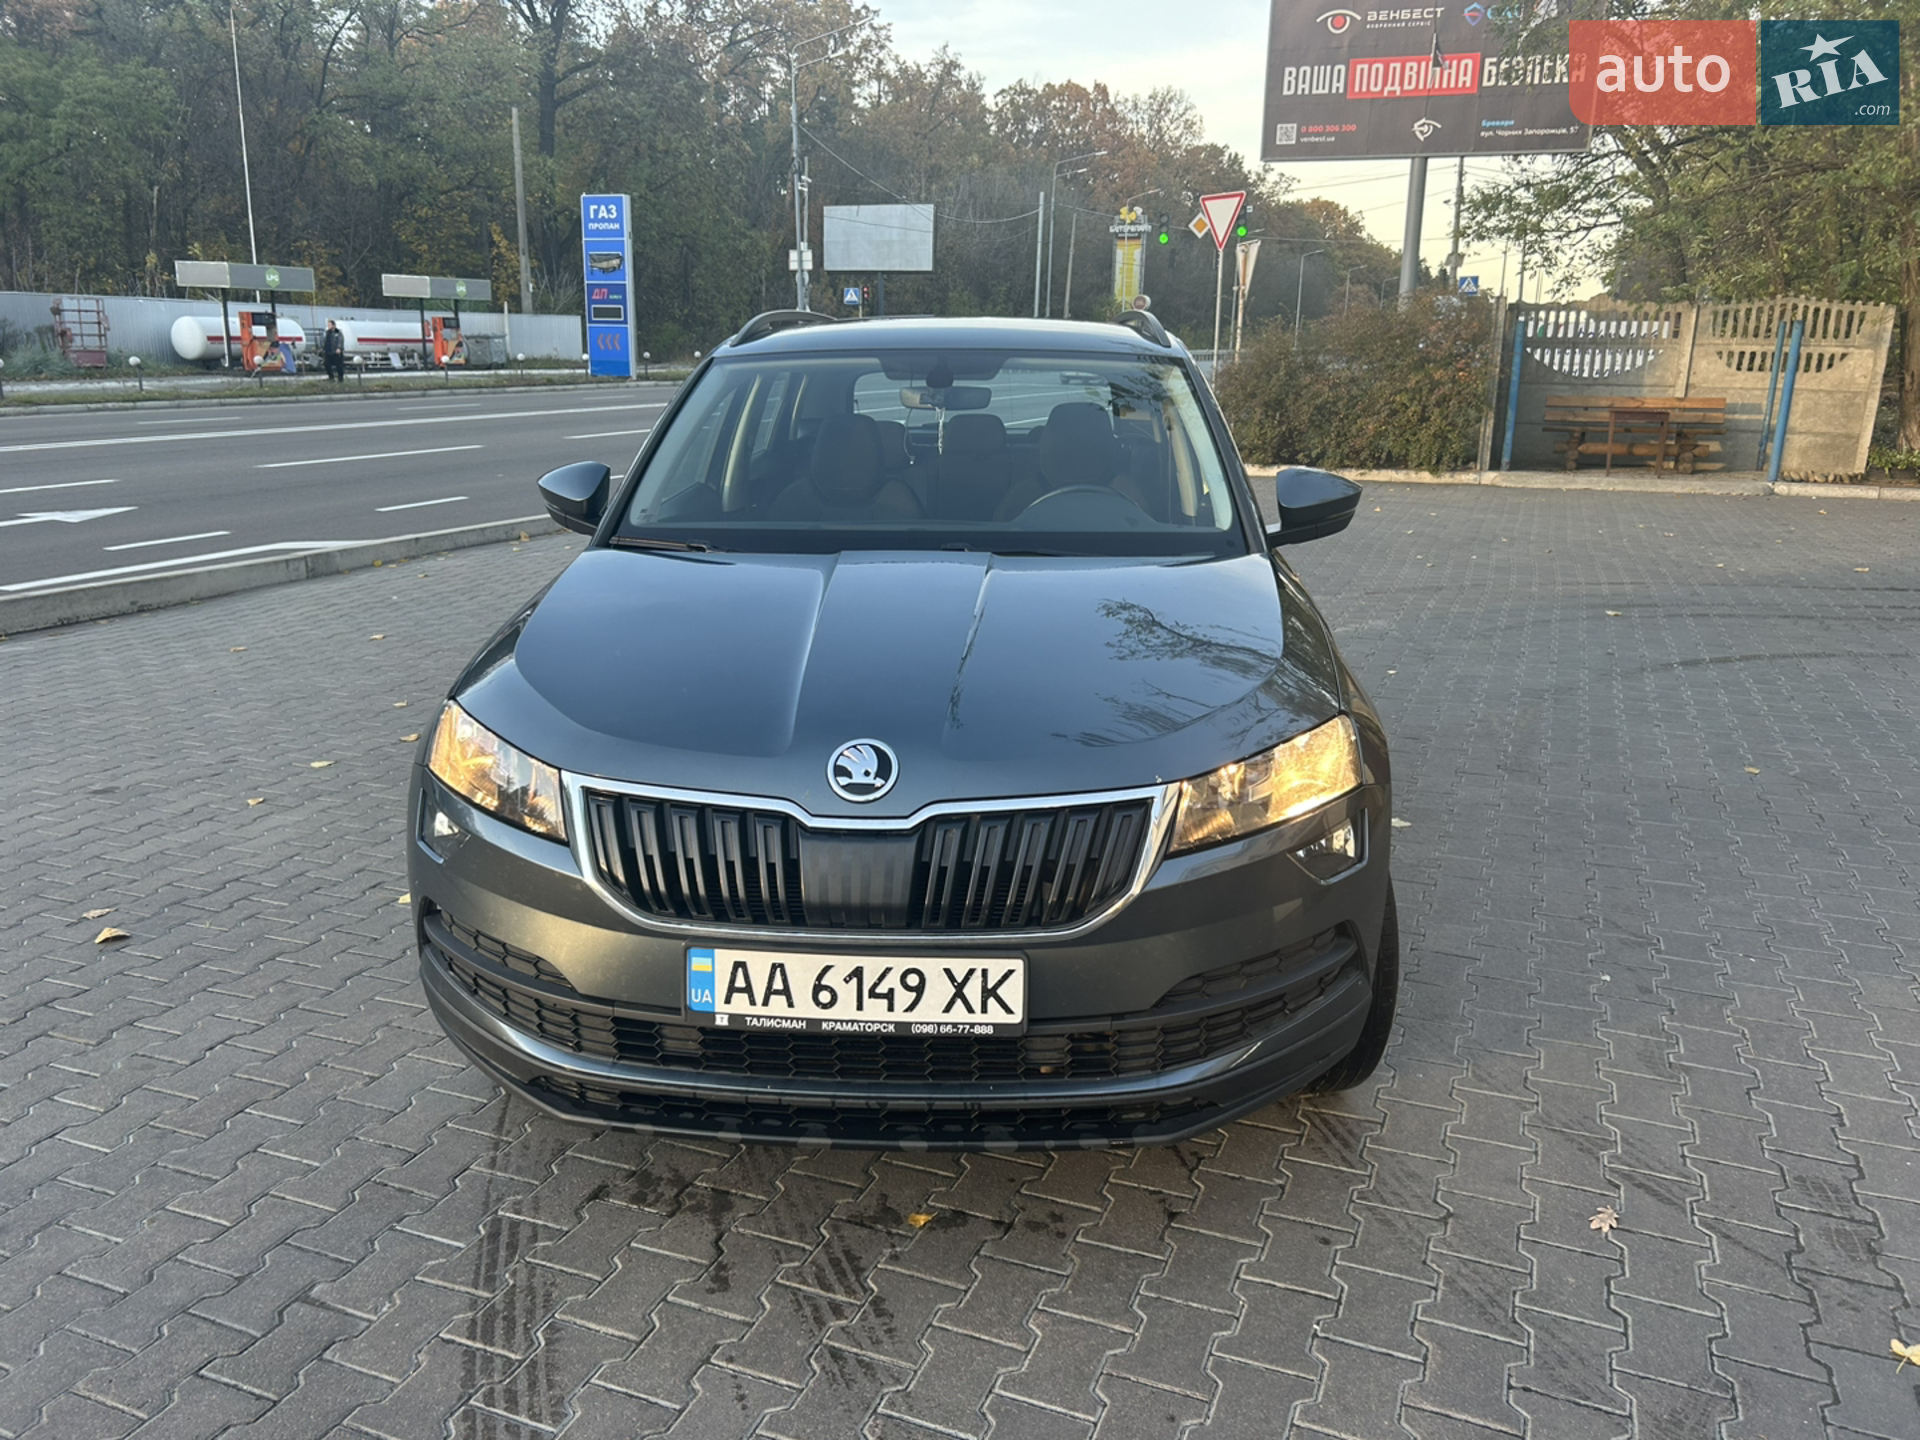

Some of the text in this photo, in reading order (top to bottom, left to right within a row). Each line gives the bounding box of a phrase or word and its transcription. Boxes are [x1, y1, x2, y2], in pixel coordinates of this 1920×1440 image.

[1366, 7, 1445, 21] ВЕНБЕСТ
[1282, 64, 1346, 96] ВАША
[589, 204, 618, 220] ГАЗ
[588, 222, 620, 231] ПРОПАН
[591, 287, 609, 300] ДП
[723, 959, 1017, 1016] AA 6149 XK
[691, 988, 713, 1004] UA
[745, 1016, 807, 1030] ТАЛИСМАН
[821, 1020, 896, 1033] КРАМАТОРСК
[911, 1023, 938, 1034] (098)
[939, 1023, 994, 1035] 66-77-888
